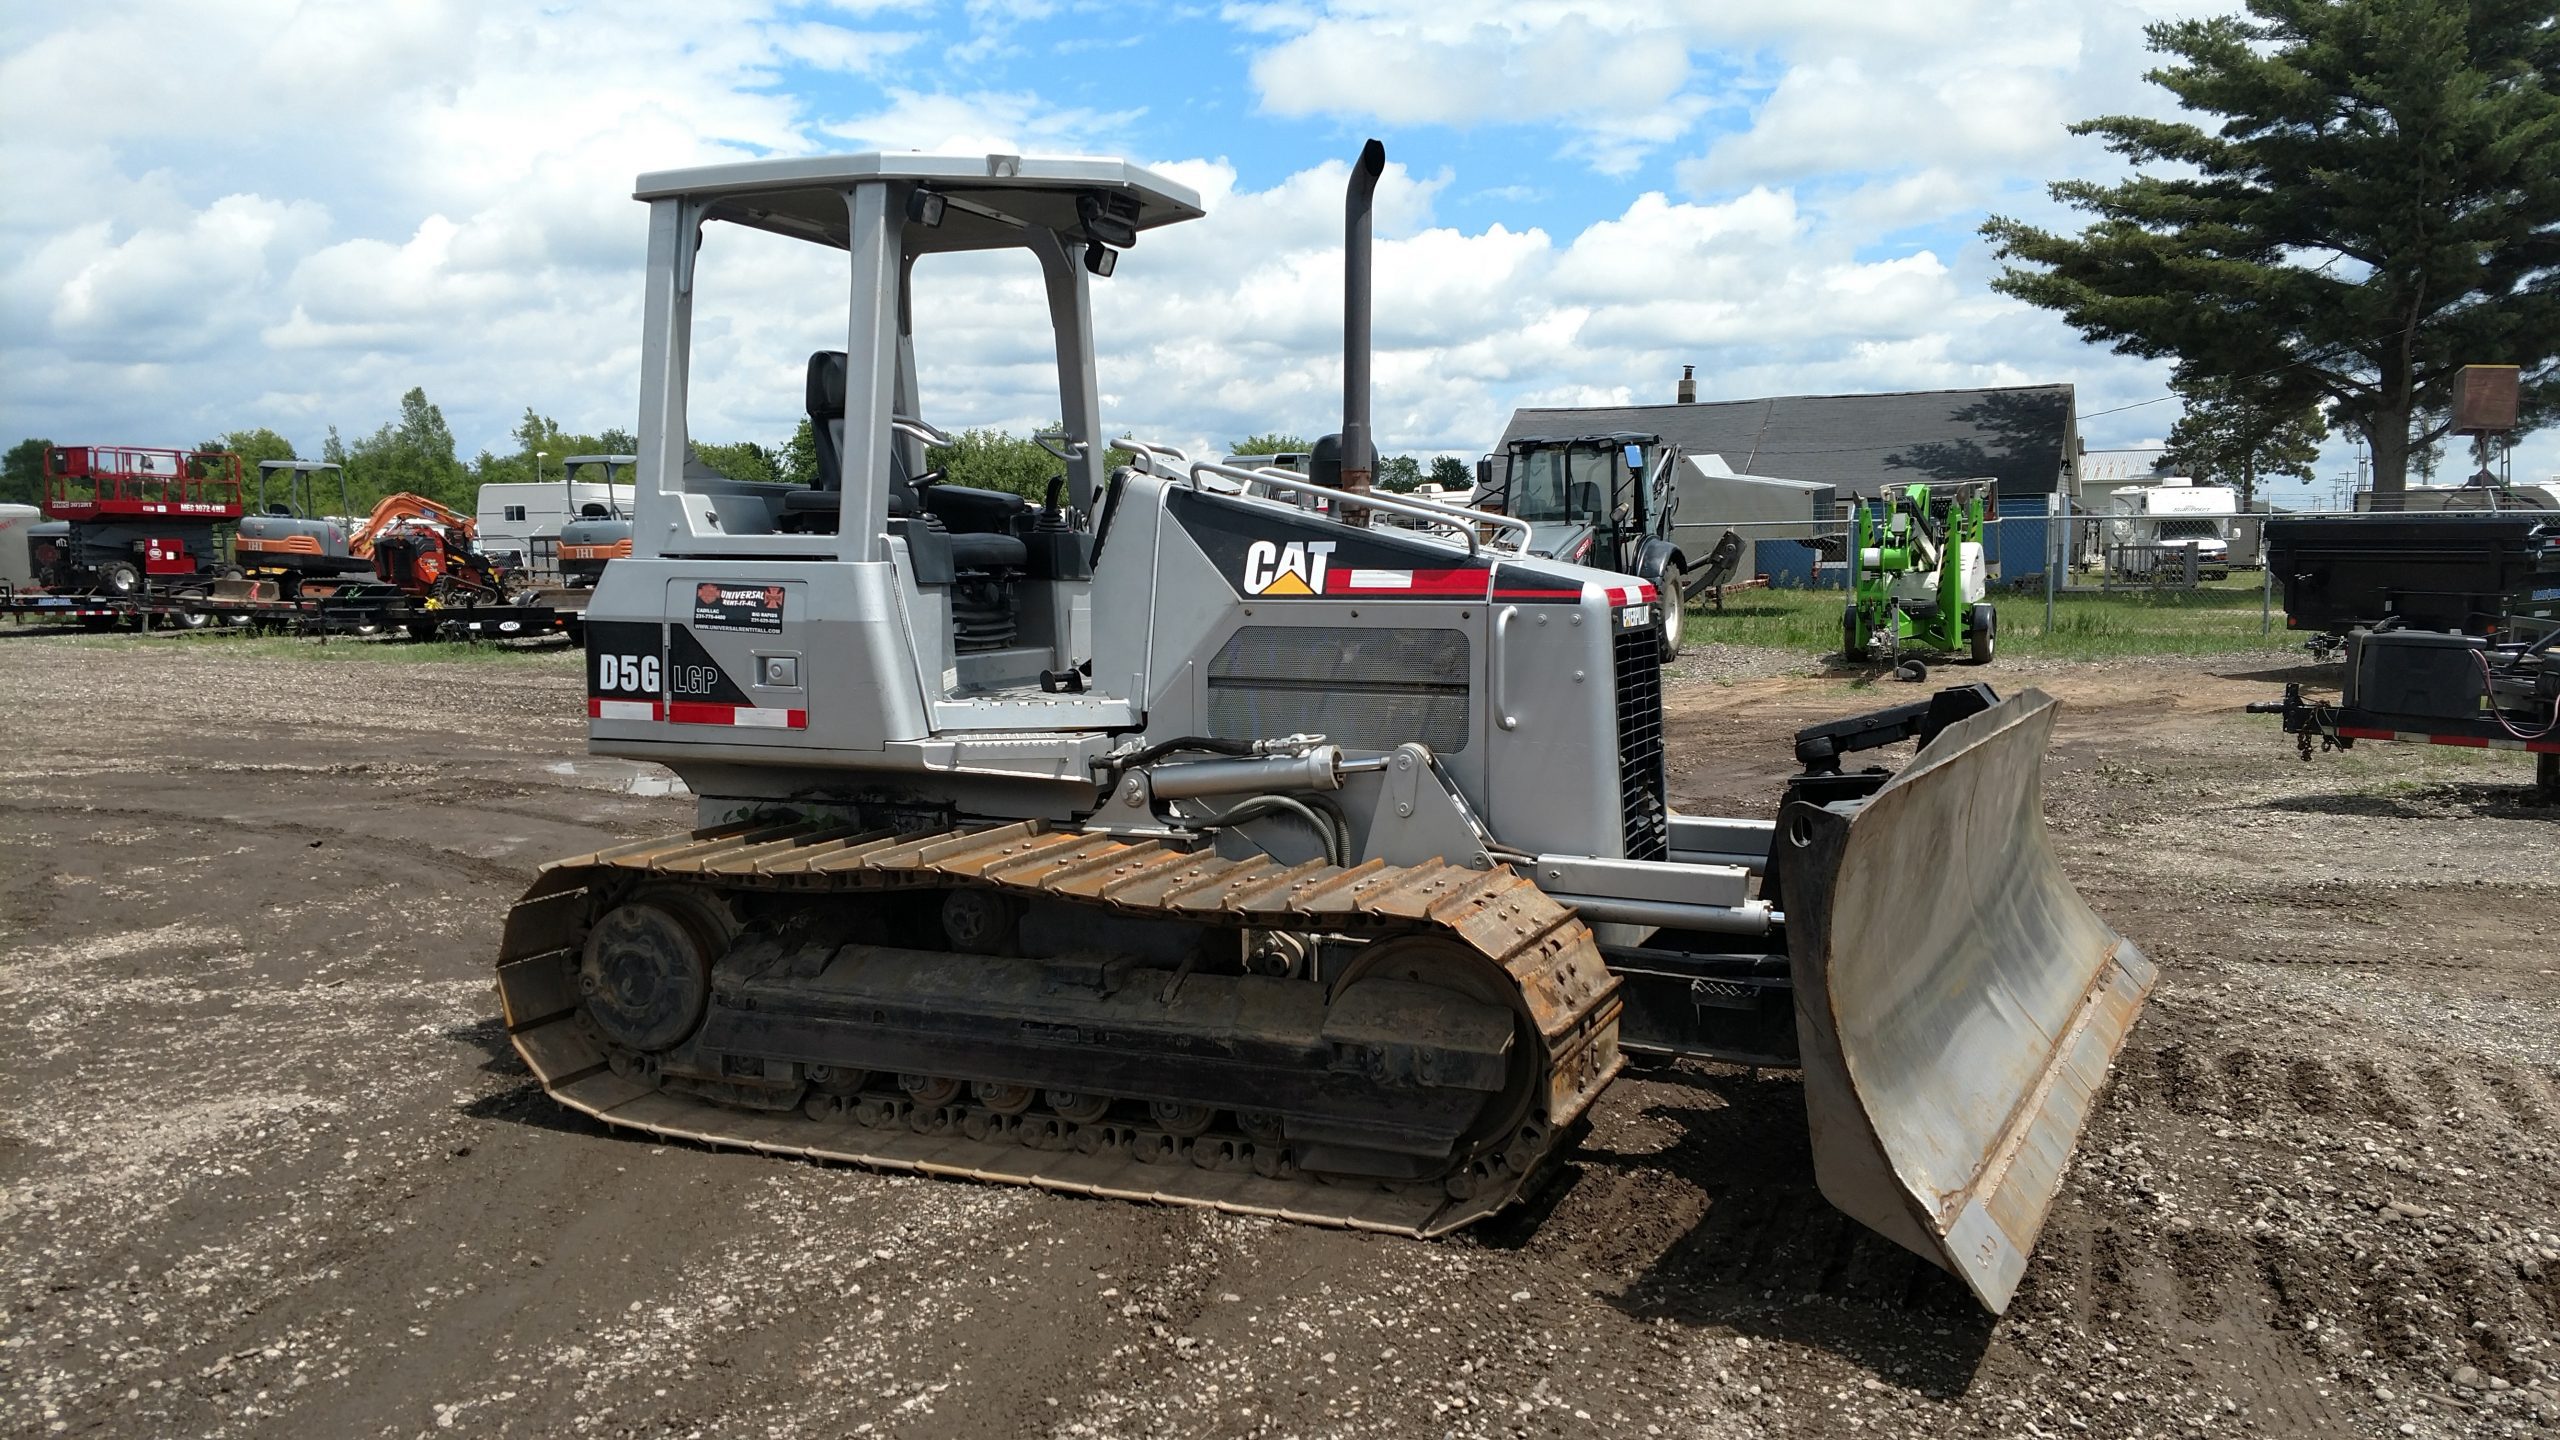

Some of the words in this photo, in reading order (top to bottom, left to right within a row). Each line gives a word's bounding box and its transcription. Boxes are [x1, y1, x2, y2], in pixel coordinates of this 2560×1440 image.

[195, 504, 210, 512] 3072
[211, 505, 226, 513] 4WD
[248, 541, 263, 551] IHI
[575, 548, 594, 559] IHI
[1243, 541, 1336, 594] CAT
[721, 590, 764, 600] UNIVERSAL
[722, 599, 757, 607] RENT-IT-ALL
[600, 654, 660, 693] D5G
[673, 665, 718, 694] LGP
